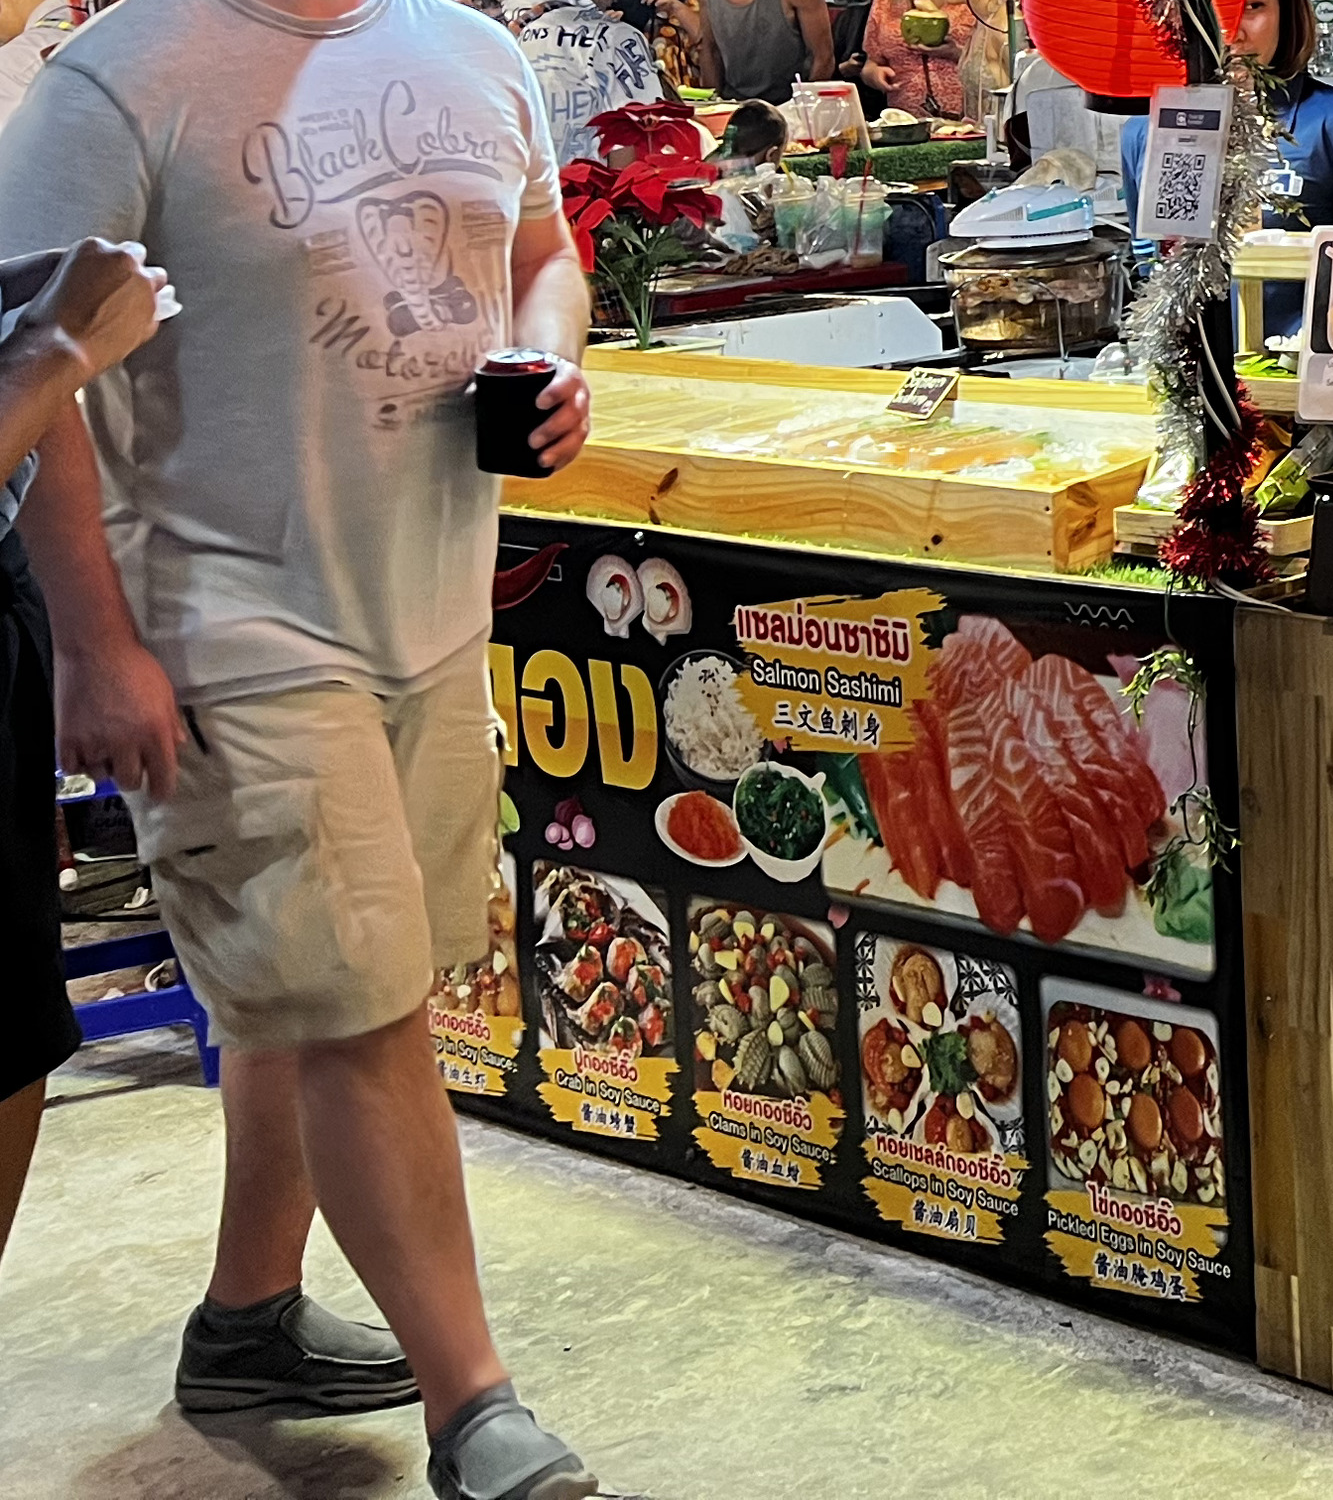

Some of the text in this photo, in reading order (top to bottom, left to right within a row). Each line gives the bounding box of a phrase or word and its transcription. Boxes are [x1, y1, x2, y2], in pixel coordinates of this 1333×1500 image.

[242, 107, 381, 229] Black
[380, 79, 500, 175] Cobra
[752, 659, 901, 705] Salmon Sashimi
[773, 702, 881, 746] 三文鱼刺身
[458, 1040, 477, 1064] Soy
[480, 1048, 512, 1072] Sauce
[556, 1069, 660, 1113] Crab in Soy Sauce
[709, 1113, 830, 1162] Clams in Soy Sauce
[873, 1160, 1019, 1217] Scallops in Soy Sauce
[1047, 1209, 1231, 1279] Pickled Eggs in Soy Sauce
